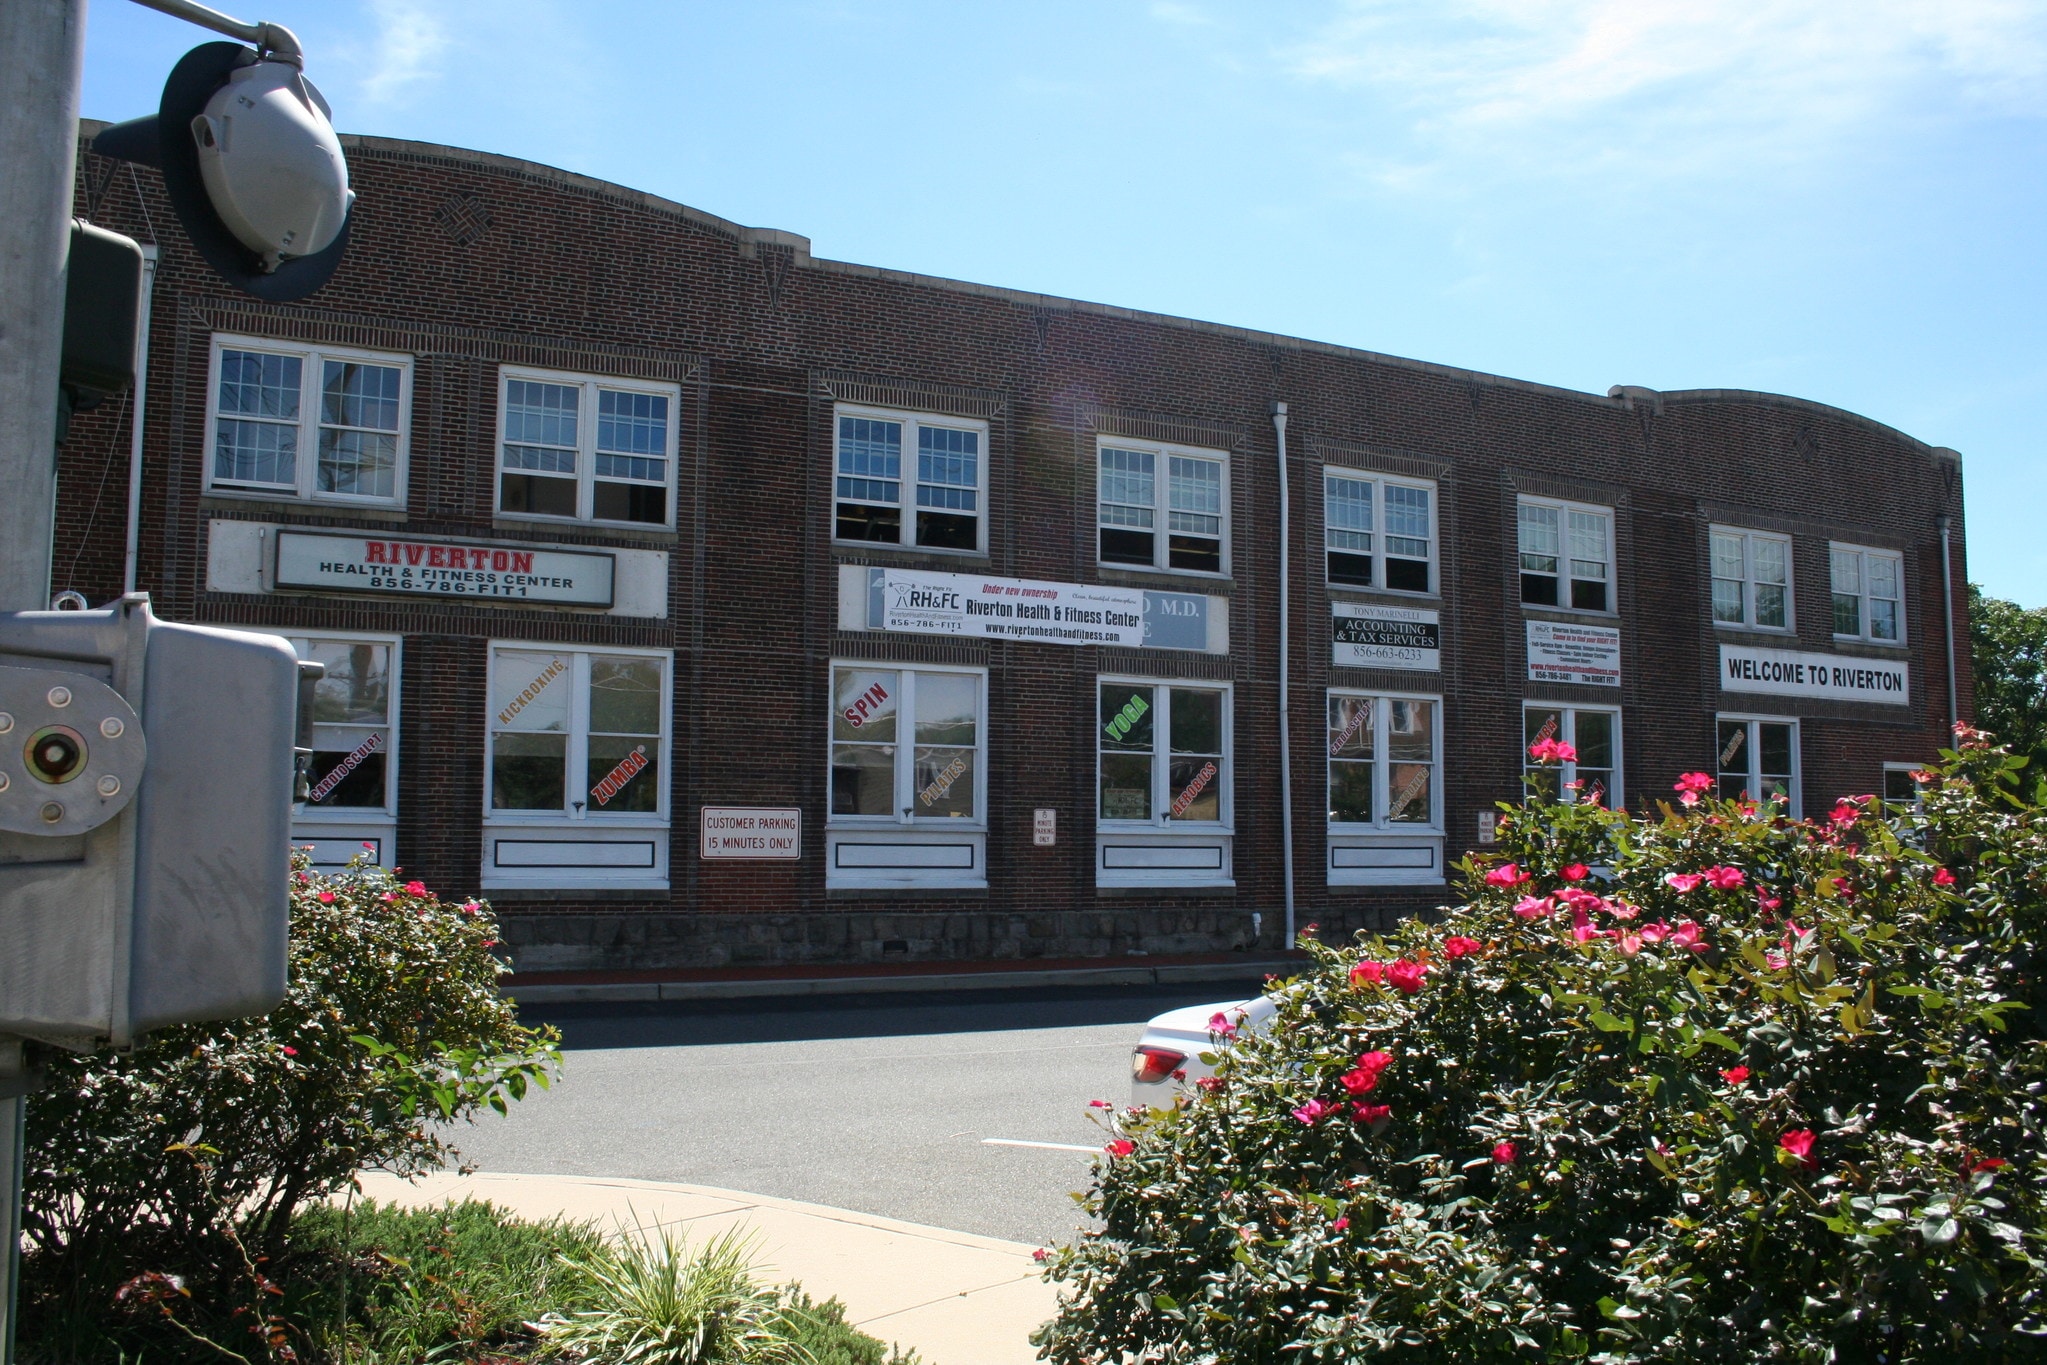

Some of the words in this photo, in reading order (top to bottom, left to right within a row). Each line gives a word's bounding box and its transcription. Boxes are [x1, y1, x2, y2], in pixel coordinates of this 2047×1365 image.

[365, 541, 535, 574] RIVERTON
[320, 562, 393, 576] HEALTH
[401, 568, 413, 578] &
[421, 569, 497, 583] FITNESS
[504, 574, 573, 588] CENTER
[371, 577, 527, 596] 856-786-FIT1
[982, 583, 1004, 594] Under
[1005, 587, 1020, 596] new
[1021, 588, 1058, 600] ownership
[910, 591, 959, 609] RH&FC
[1160, 599, 1200, 617] M.D.
[966, 599, 1012, 617] Riverton
[1016, 603, 1050, 620] Health
[1053, 606, 1062, 621] &
[1065, 607, 1102, 624] Fitness
[1105, 610, 1140, 627] Center
[1353, 607, 1375, 617] TONY
[1376, 609, 1419, 620] MARINELLI
[891, 619, 962, 629] 856-786-FIT1
[985, 623, 1120, 641] www.rivertonhealthandfitness.com
[1345, 620, 1426, 635] ACCOUNTING
[1336, 630, 1346, 641] &
[1349, 631, 1376, 643] TAX
[1379, 633, 1435, 647] SERVICES
[1353, 645, 1422, 660] 856-663-6233
[1582, 674, 1591, 682] The
[1591, 675, 1606, 683] RIGHT
[1728, 658, 1804, 684] WELCOME
[1808, 665, 1828, 686] TO
[1833, 667, 1902, 692] RIVERTON
[498, 659, 565, 725] KICKBOXING
[844, 681, 889, 728] SPIN
[1104, 694, 1149, 741] YOGA
[1330, 726, 1353, 755] CARDIO
[310, 764, 349, 801] CARDIO
[344, 731, 383, 769] SCULPT
[591, 749, 648, 806] ZUMBA
[920, 757, 966, 807] PILATES
[1171, 761, 1217, 816] AEROBICS
[707, 817, 755, 829] CUSTOMER
[758, 818, 796, 829] PARKING
[708, 837, 718, 848] 15
[722, 837, 765, 849] MINUTES
[769, 838, 794, 849] ONLY
